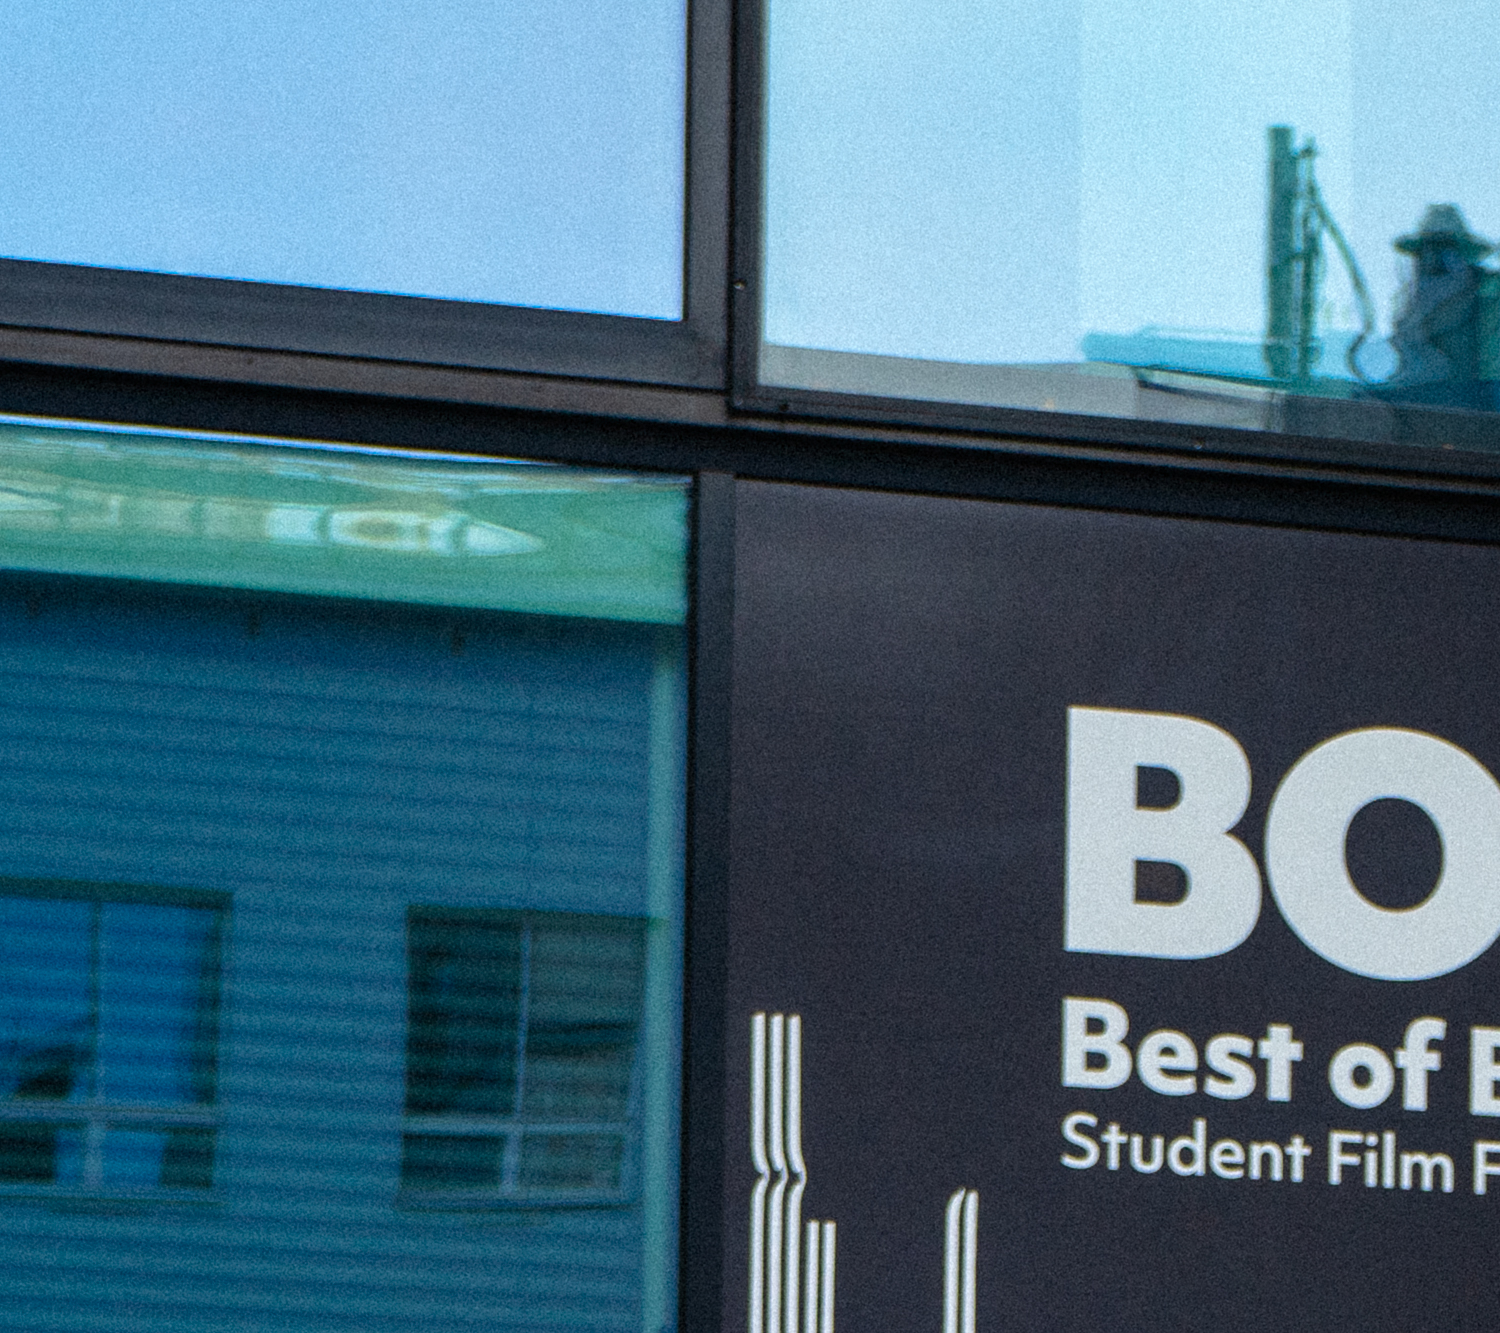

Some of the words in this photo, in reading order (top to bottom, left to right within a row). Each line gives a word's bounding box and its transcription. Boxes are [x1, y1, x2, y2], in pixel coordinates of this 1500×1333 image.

[1061, 996, 1304, 1103] Best
[1328, 1016, 1448, 1112] of
[1060, 1111, 1312, 1184] Student
[1328, 1130, 1455, 1194] Film
